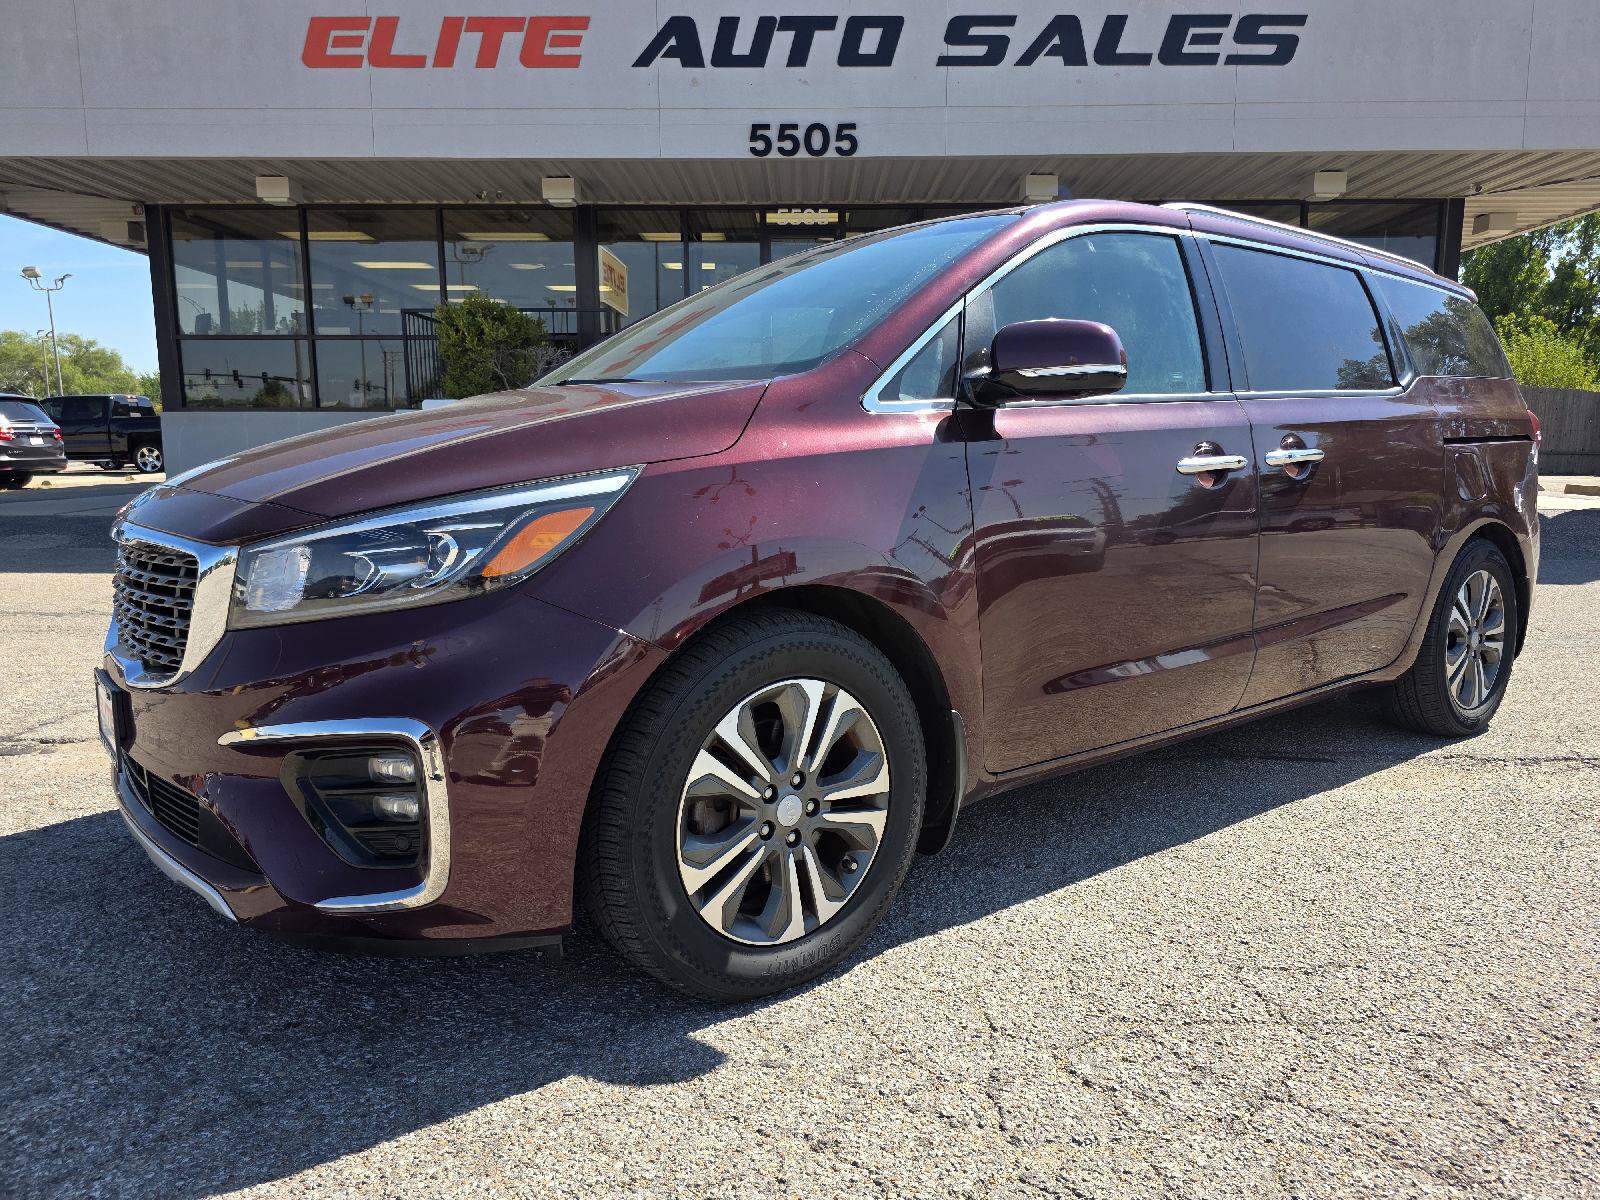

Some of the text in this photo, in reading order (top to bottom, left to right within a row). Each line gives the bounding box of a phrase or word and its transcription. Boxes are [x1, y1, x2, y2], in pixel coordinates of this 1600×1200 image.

[302, 13, 1309, 69] ELITE AUTO SALES
[749, 122, 858, 157] 5505
[776, 208, 829, 226] 5505
